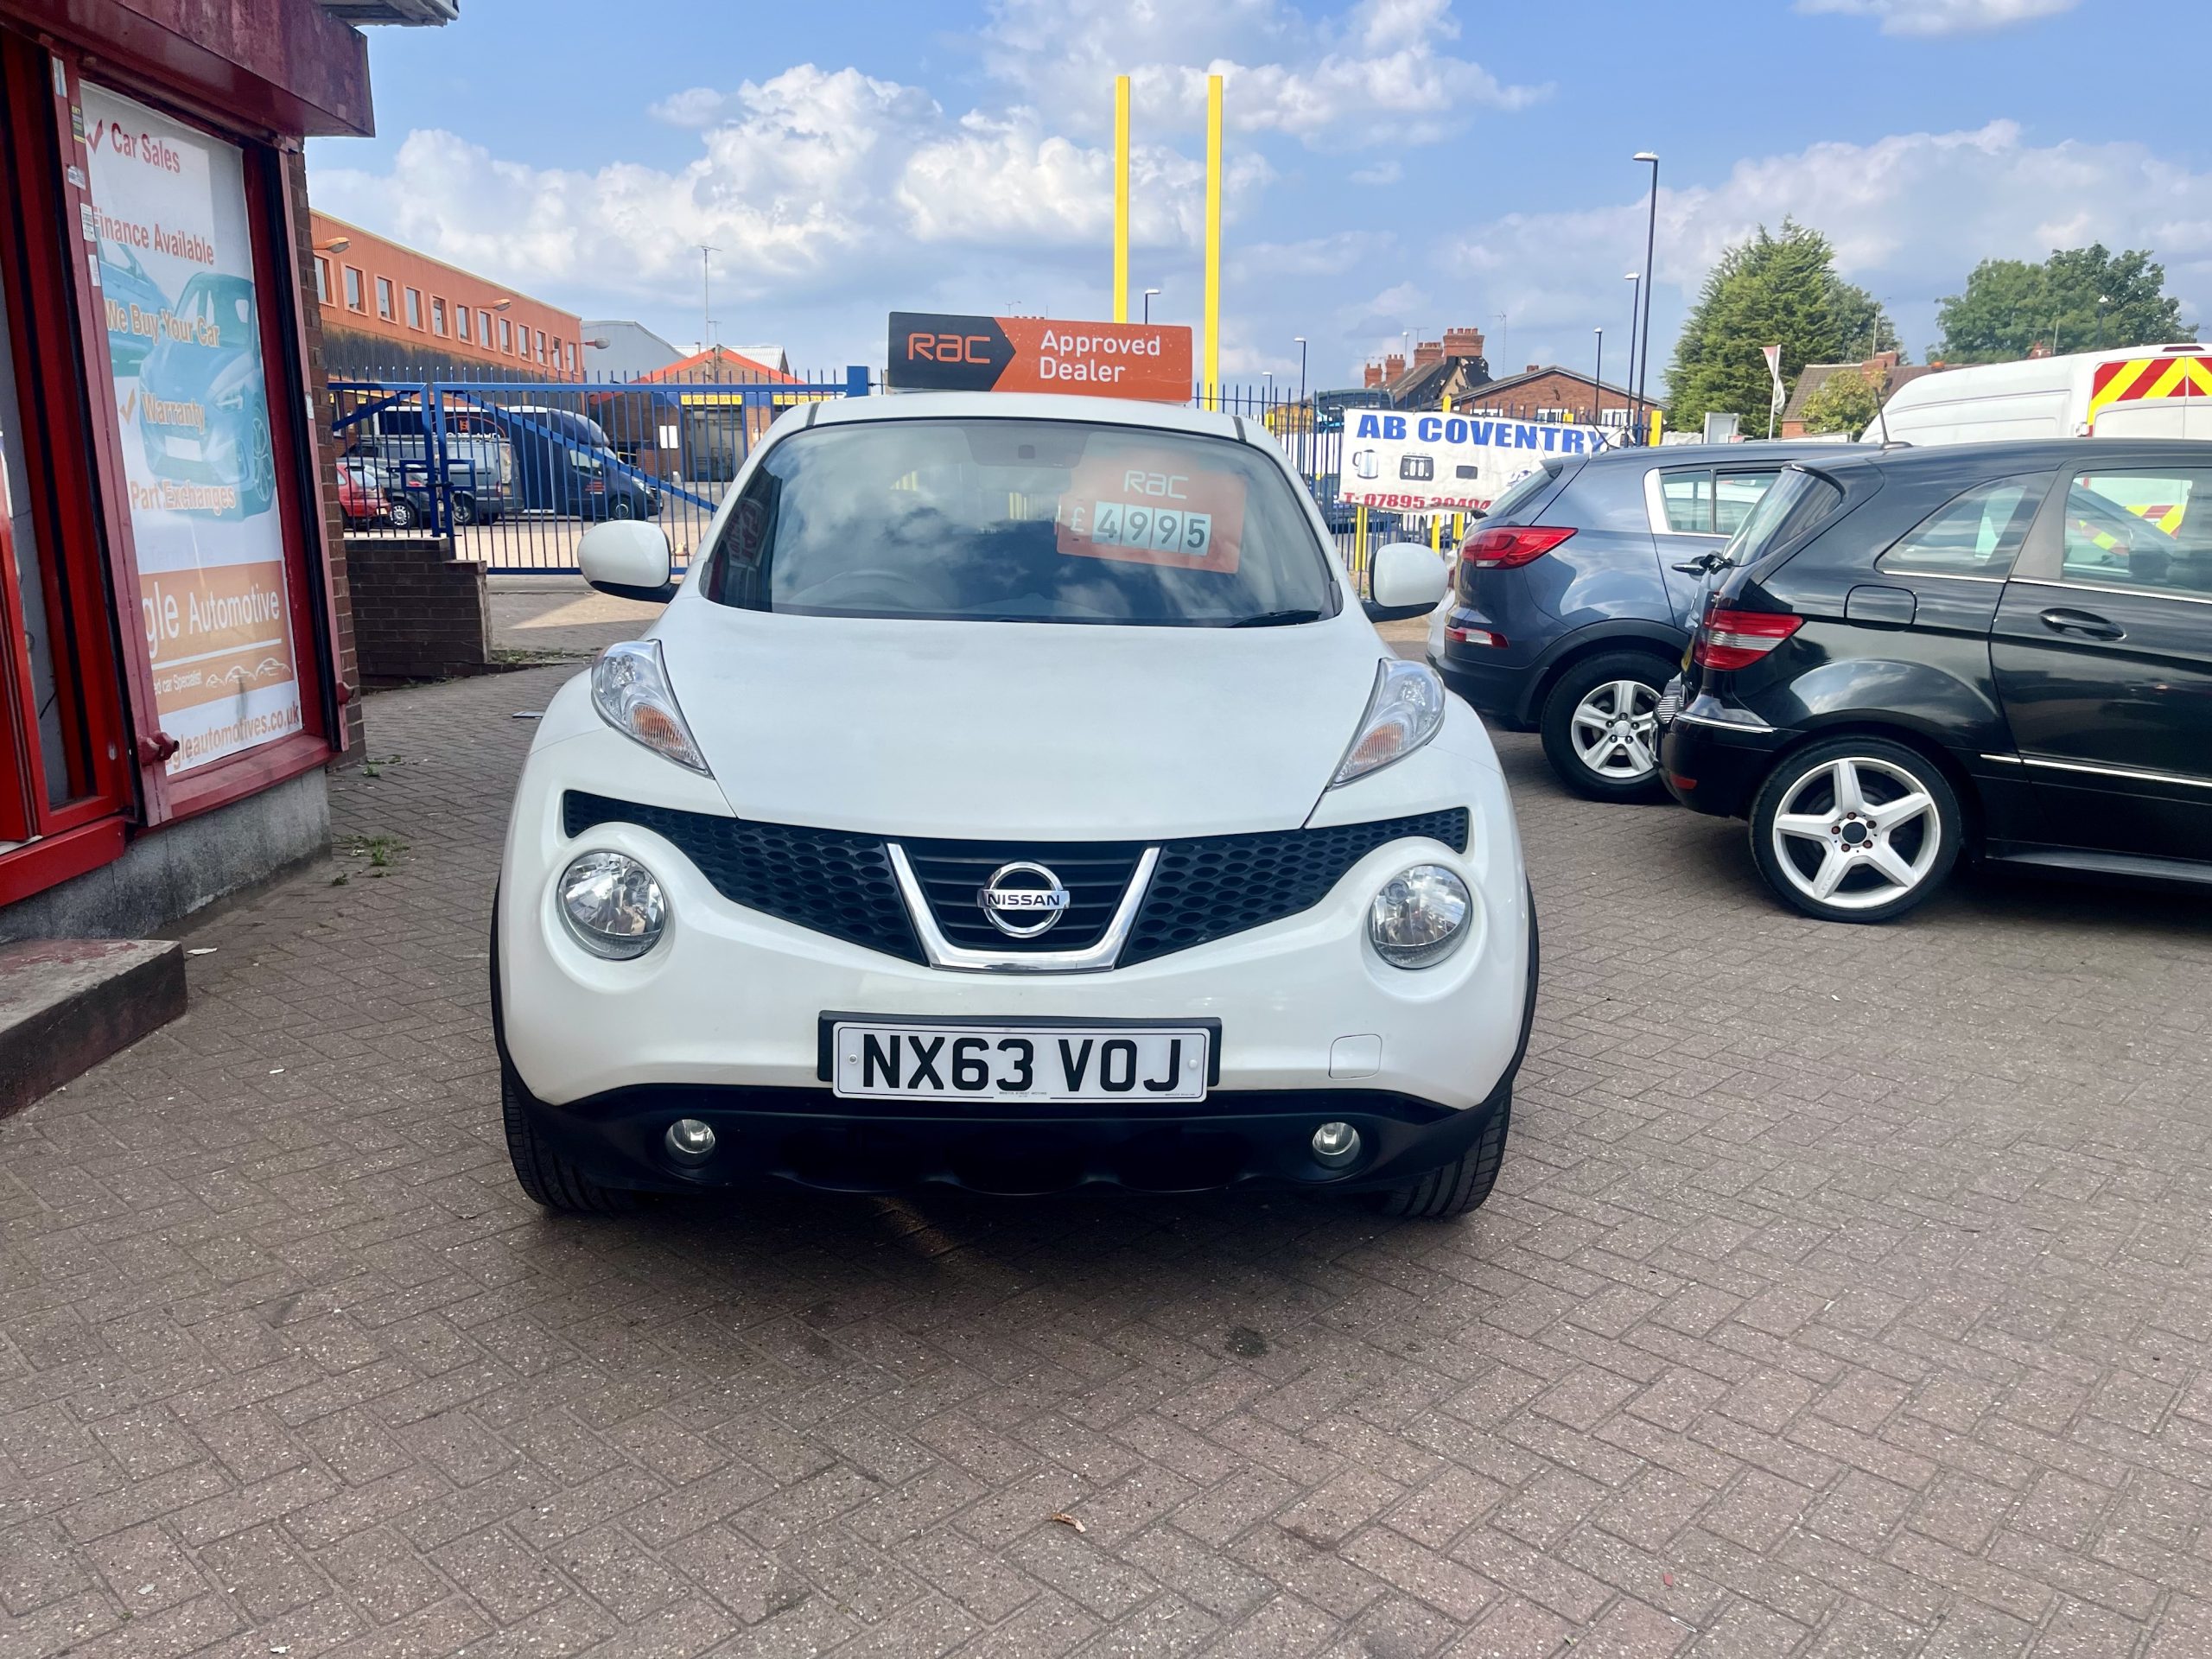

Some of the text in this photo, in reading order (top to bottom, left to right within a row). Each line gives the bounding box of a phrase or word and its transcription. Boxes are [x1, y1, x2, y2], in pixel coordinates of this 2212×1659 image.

[111, 122, 137, 158] Car
[141, 133, 181, 173] Sales
[154, 223, 213, 265] Available
[105, 298, 219, 346] We Buy Your Car
[1039, 329, 1160, 358] Approved
[1039, 357, 1126, 383] Dealer
[142, 393, 205, 435] Warranty
[1357, 414, 1610, 454] AB COVENTRY
[131, 479, 236, 517] Part Exchanges
[1364, 493, 1425, 509] 07895
[189, 582, 280, 635] Automotive
[987, 893, 1060, 906] NISSAN
[862, 1033, 1182, 1092] NX63 VOJ
